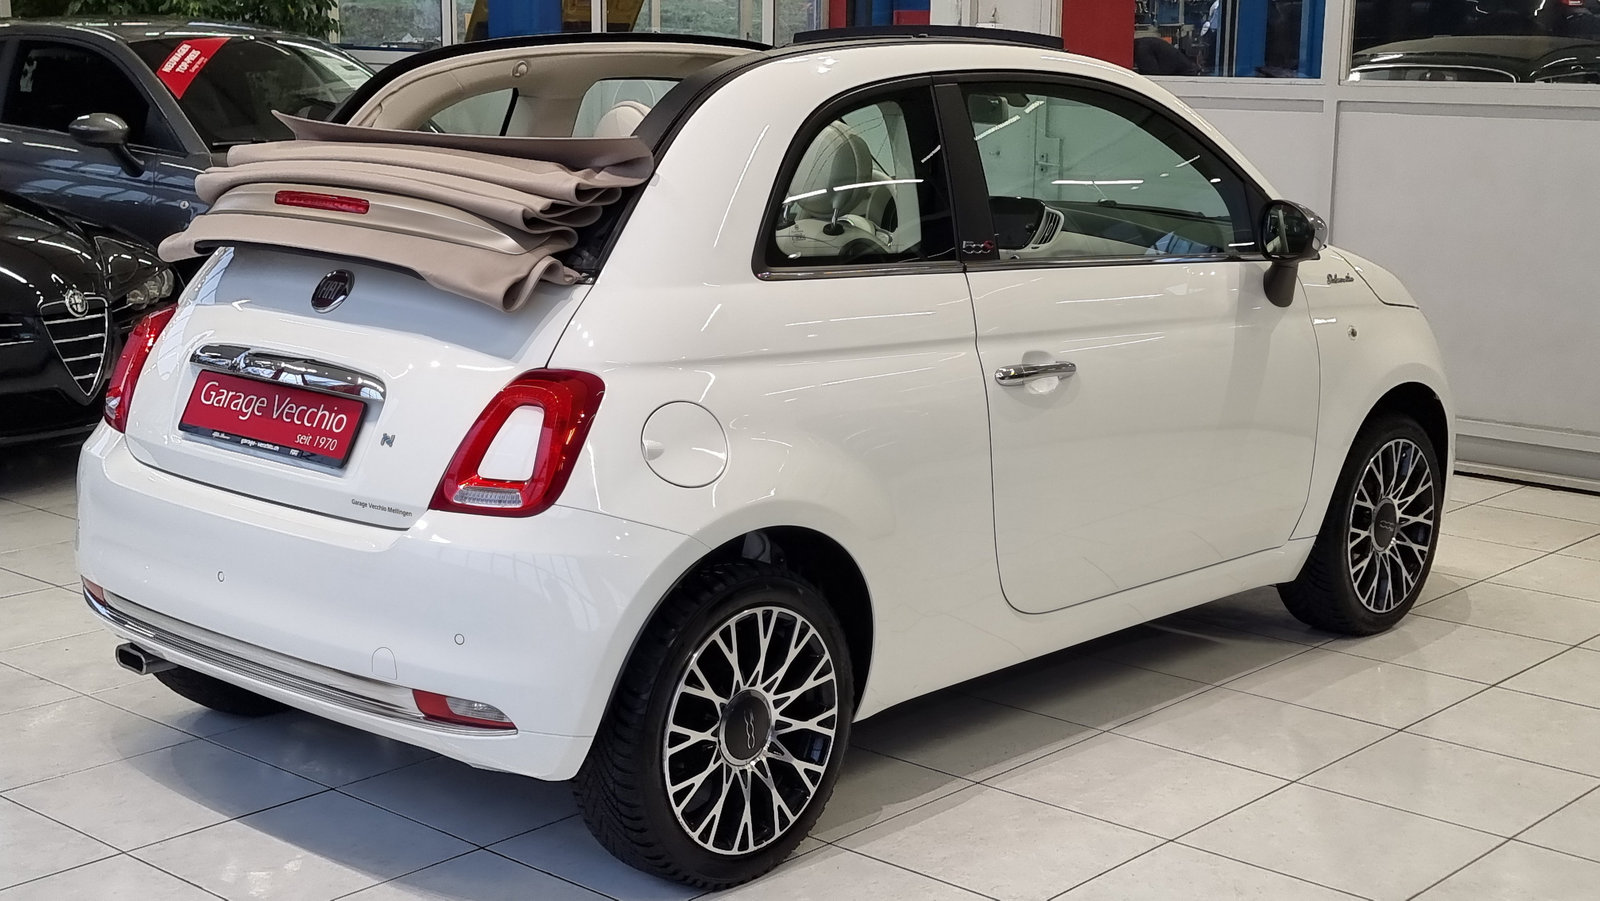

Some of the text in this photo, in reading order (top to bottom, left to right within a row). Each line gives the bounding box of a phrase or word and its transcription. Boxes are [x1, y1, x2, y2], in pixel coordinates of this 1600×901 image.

[316, 280, 345, 300] FIAT
[200, 381, 348, 433] Garage Vecchio
[294, 433, 338, 451] seit 1970
[351, 498, 413, 517] Garage Vecchio Mellingen
